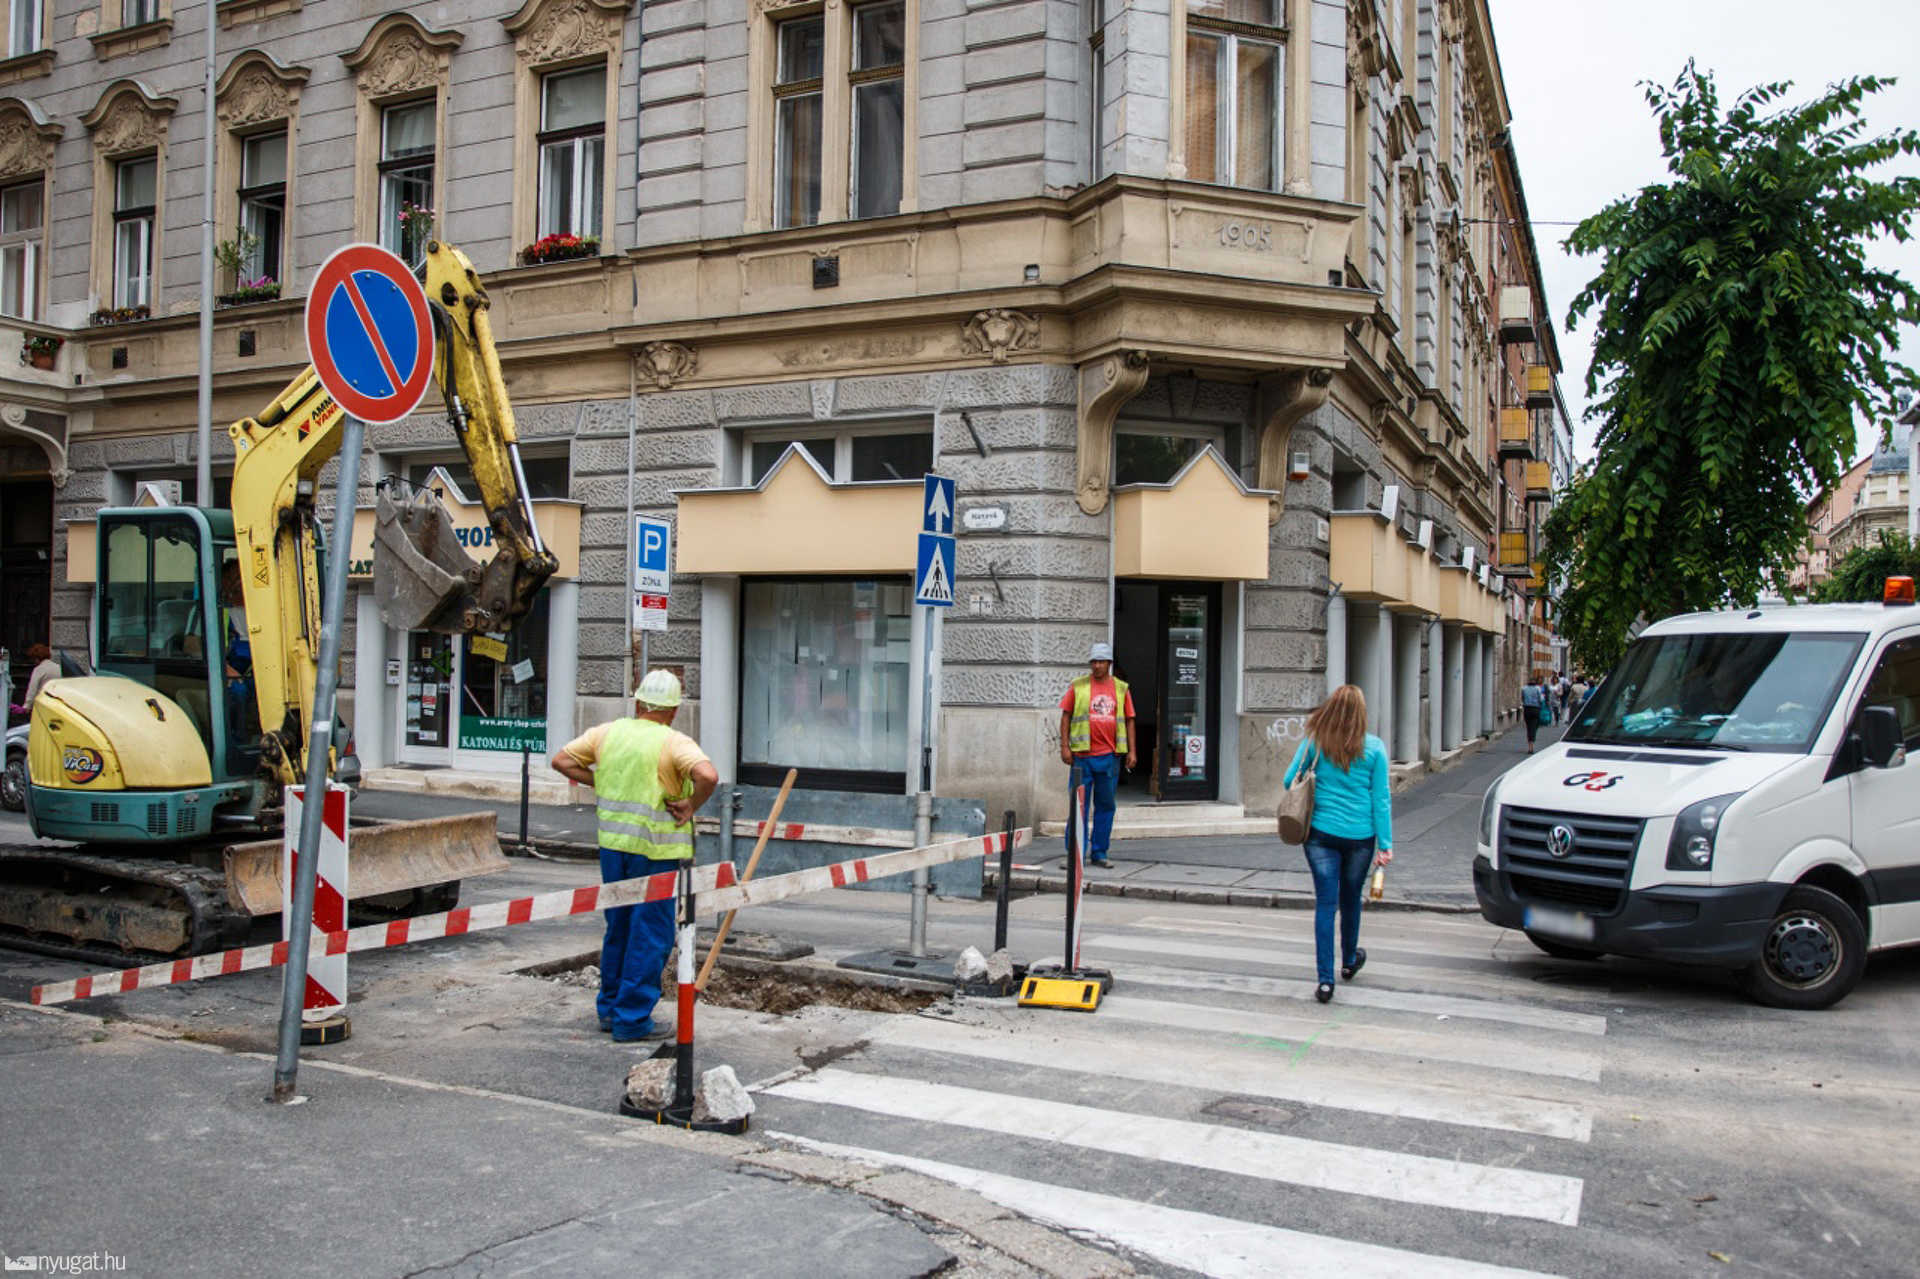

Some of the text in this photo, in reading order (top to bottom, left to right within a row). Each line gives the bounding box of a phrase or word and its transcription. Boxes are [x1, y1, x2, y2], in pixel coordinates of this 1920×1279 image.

[1215, 223, 1272, 251] 1905
[312, 395, 334, 420] AMM
[456, 526, 494, 547] HOP
[644, 530, 662, 564] P
[461, 735, 507, 749] KATONAI
[524, 736, 547, 752] TÚR
[1563, 771, 1624, 791] G4S
